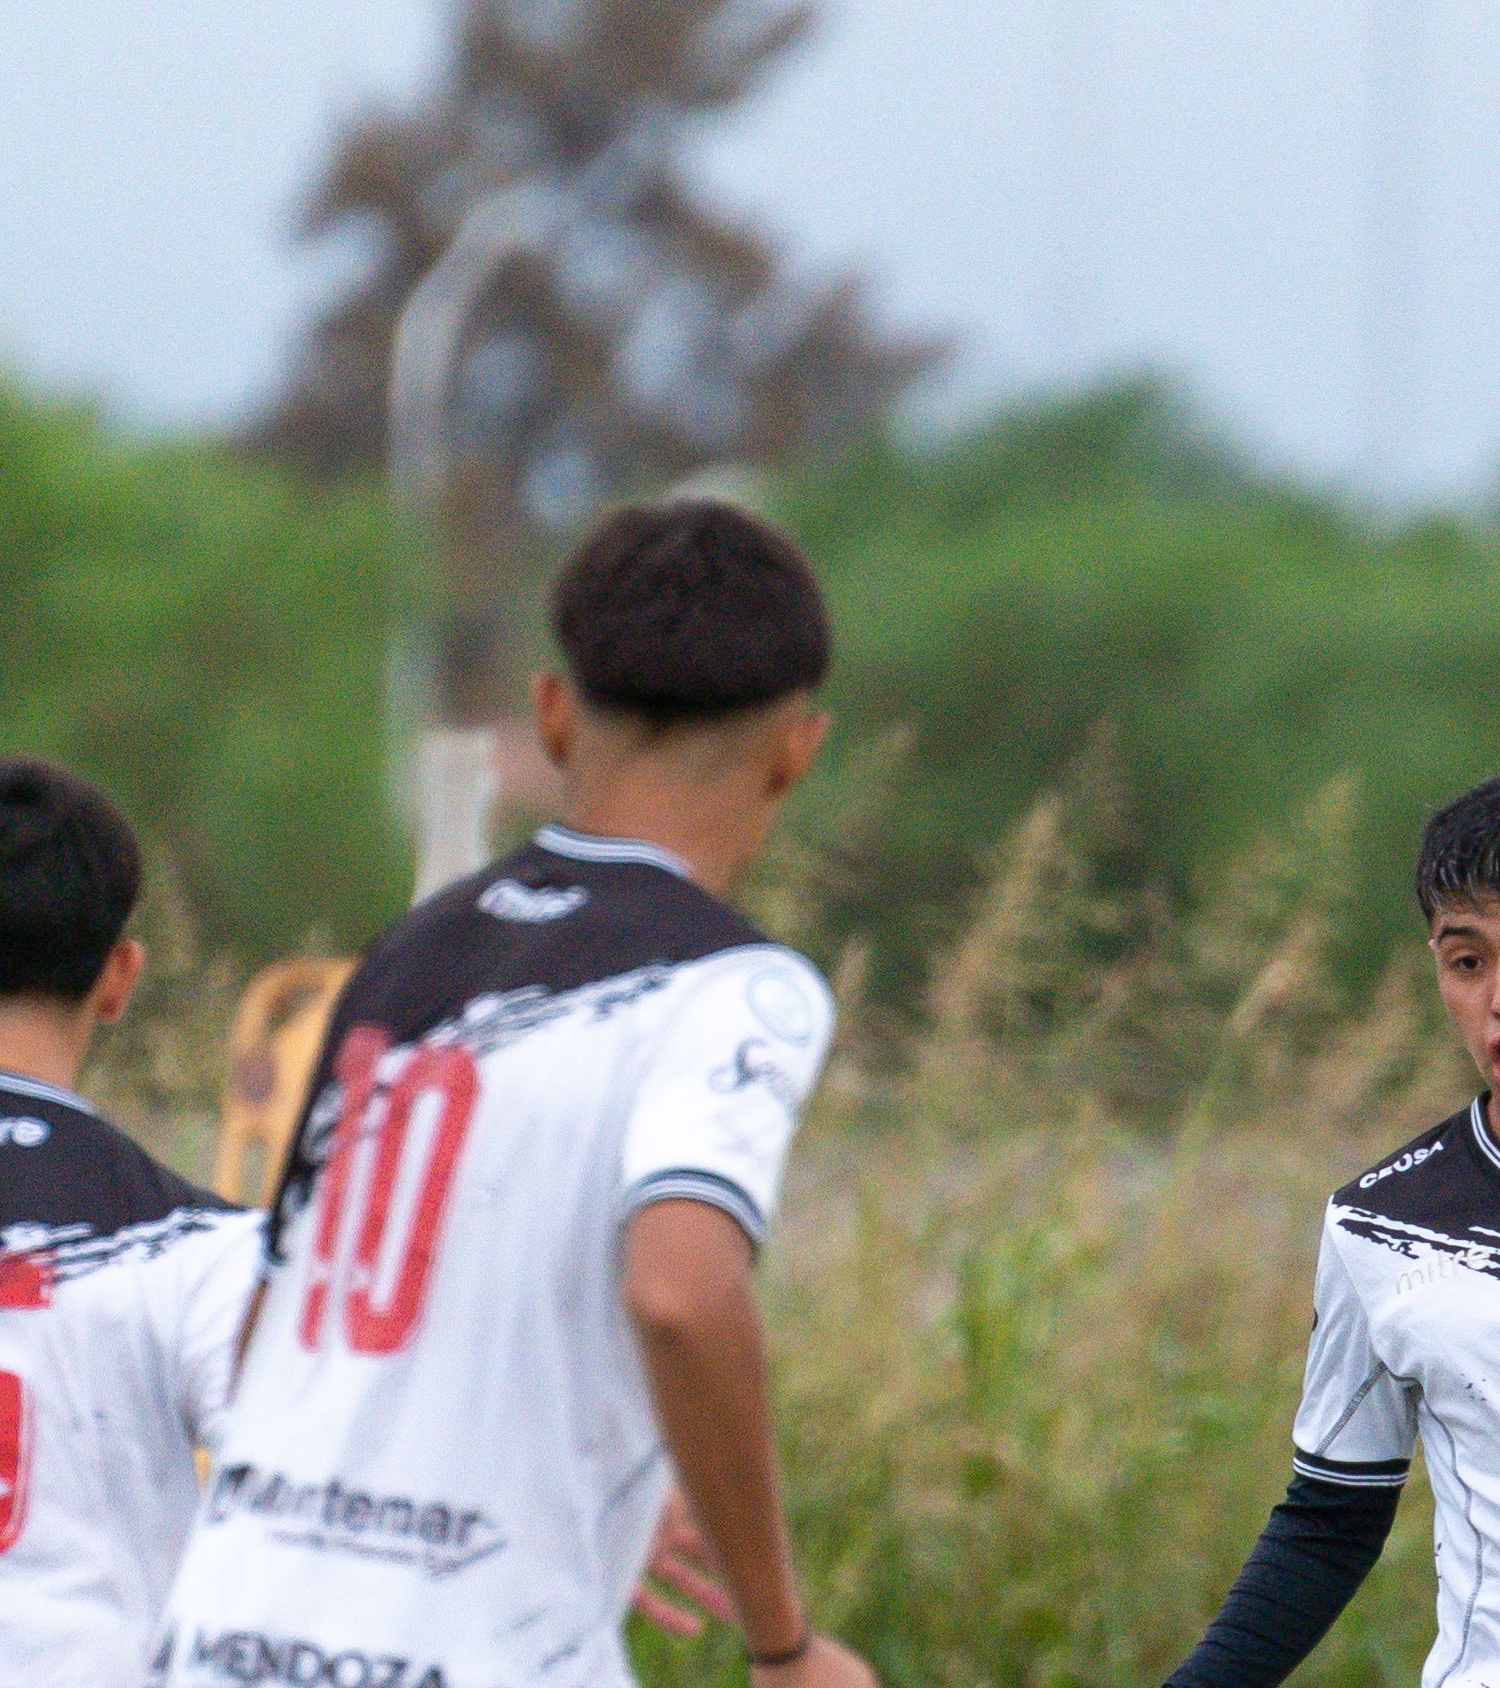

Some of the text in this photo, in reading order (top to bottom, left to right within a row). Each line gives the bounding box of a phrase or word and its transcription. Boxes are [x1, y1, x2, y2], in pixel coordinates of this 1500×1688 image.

[1359, 1140, 1445, 1189] CEOSA
[296, 1025, 478, 1357] 10
[1396, 1246, 1491, 1295] mitre
